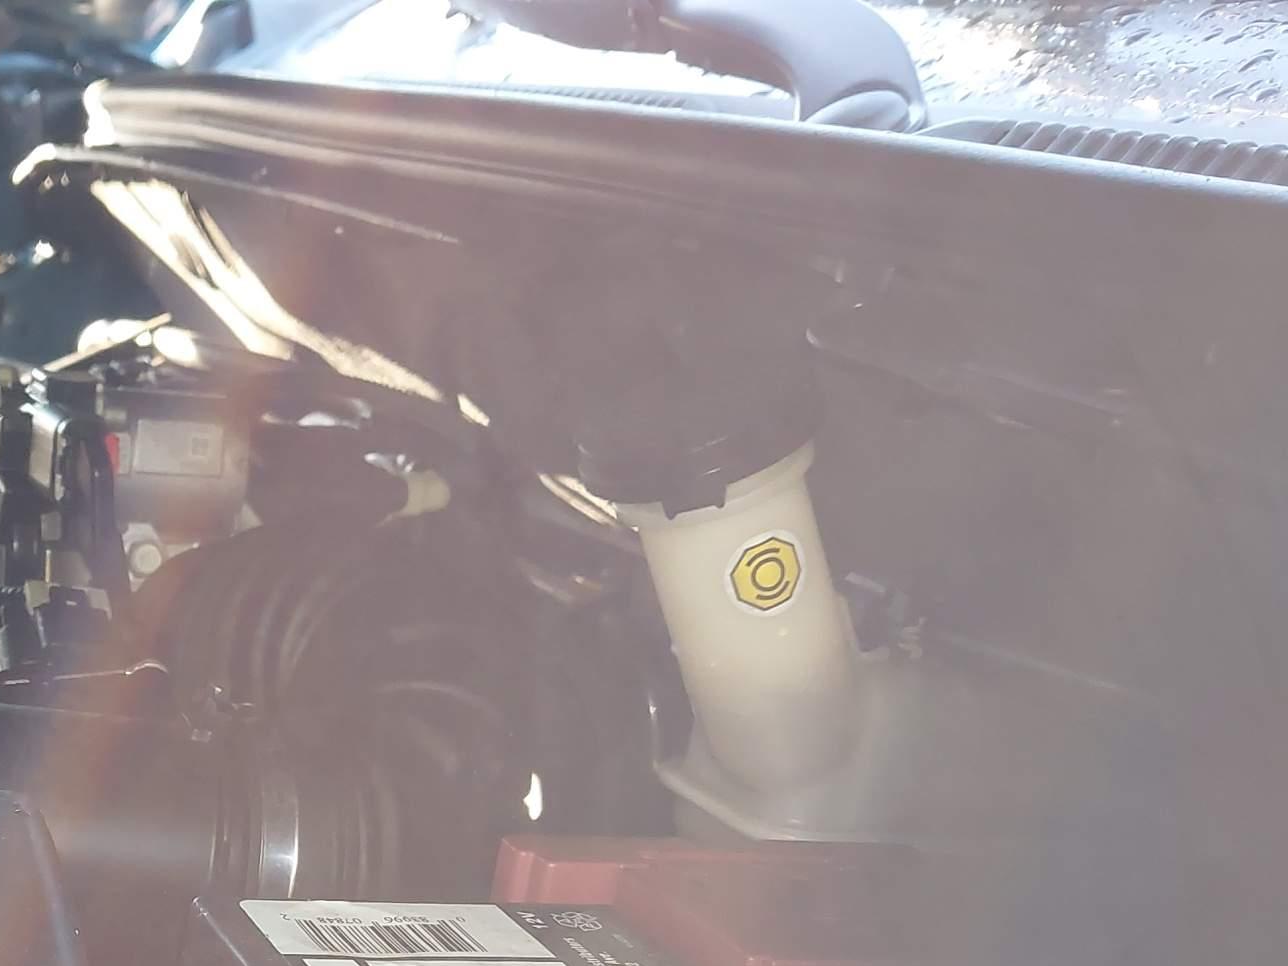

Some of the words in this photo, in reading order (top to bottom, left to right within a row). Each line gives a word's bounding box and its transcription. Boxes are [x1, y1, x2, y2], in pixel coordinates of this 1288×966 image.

[317, 916, 362, 925] 07848
[384, 916, 430, 924] 83996
[516, 911, 548, 929] 12V
